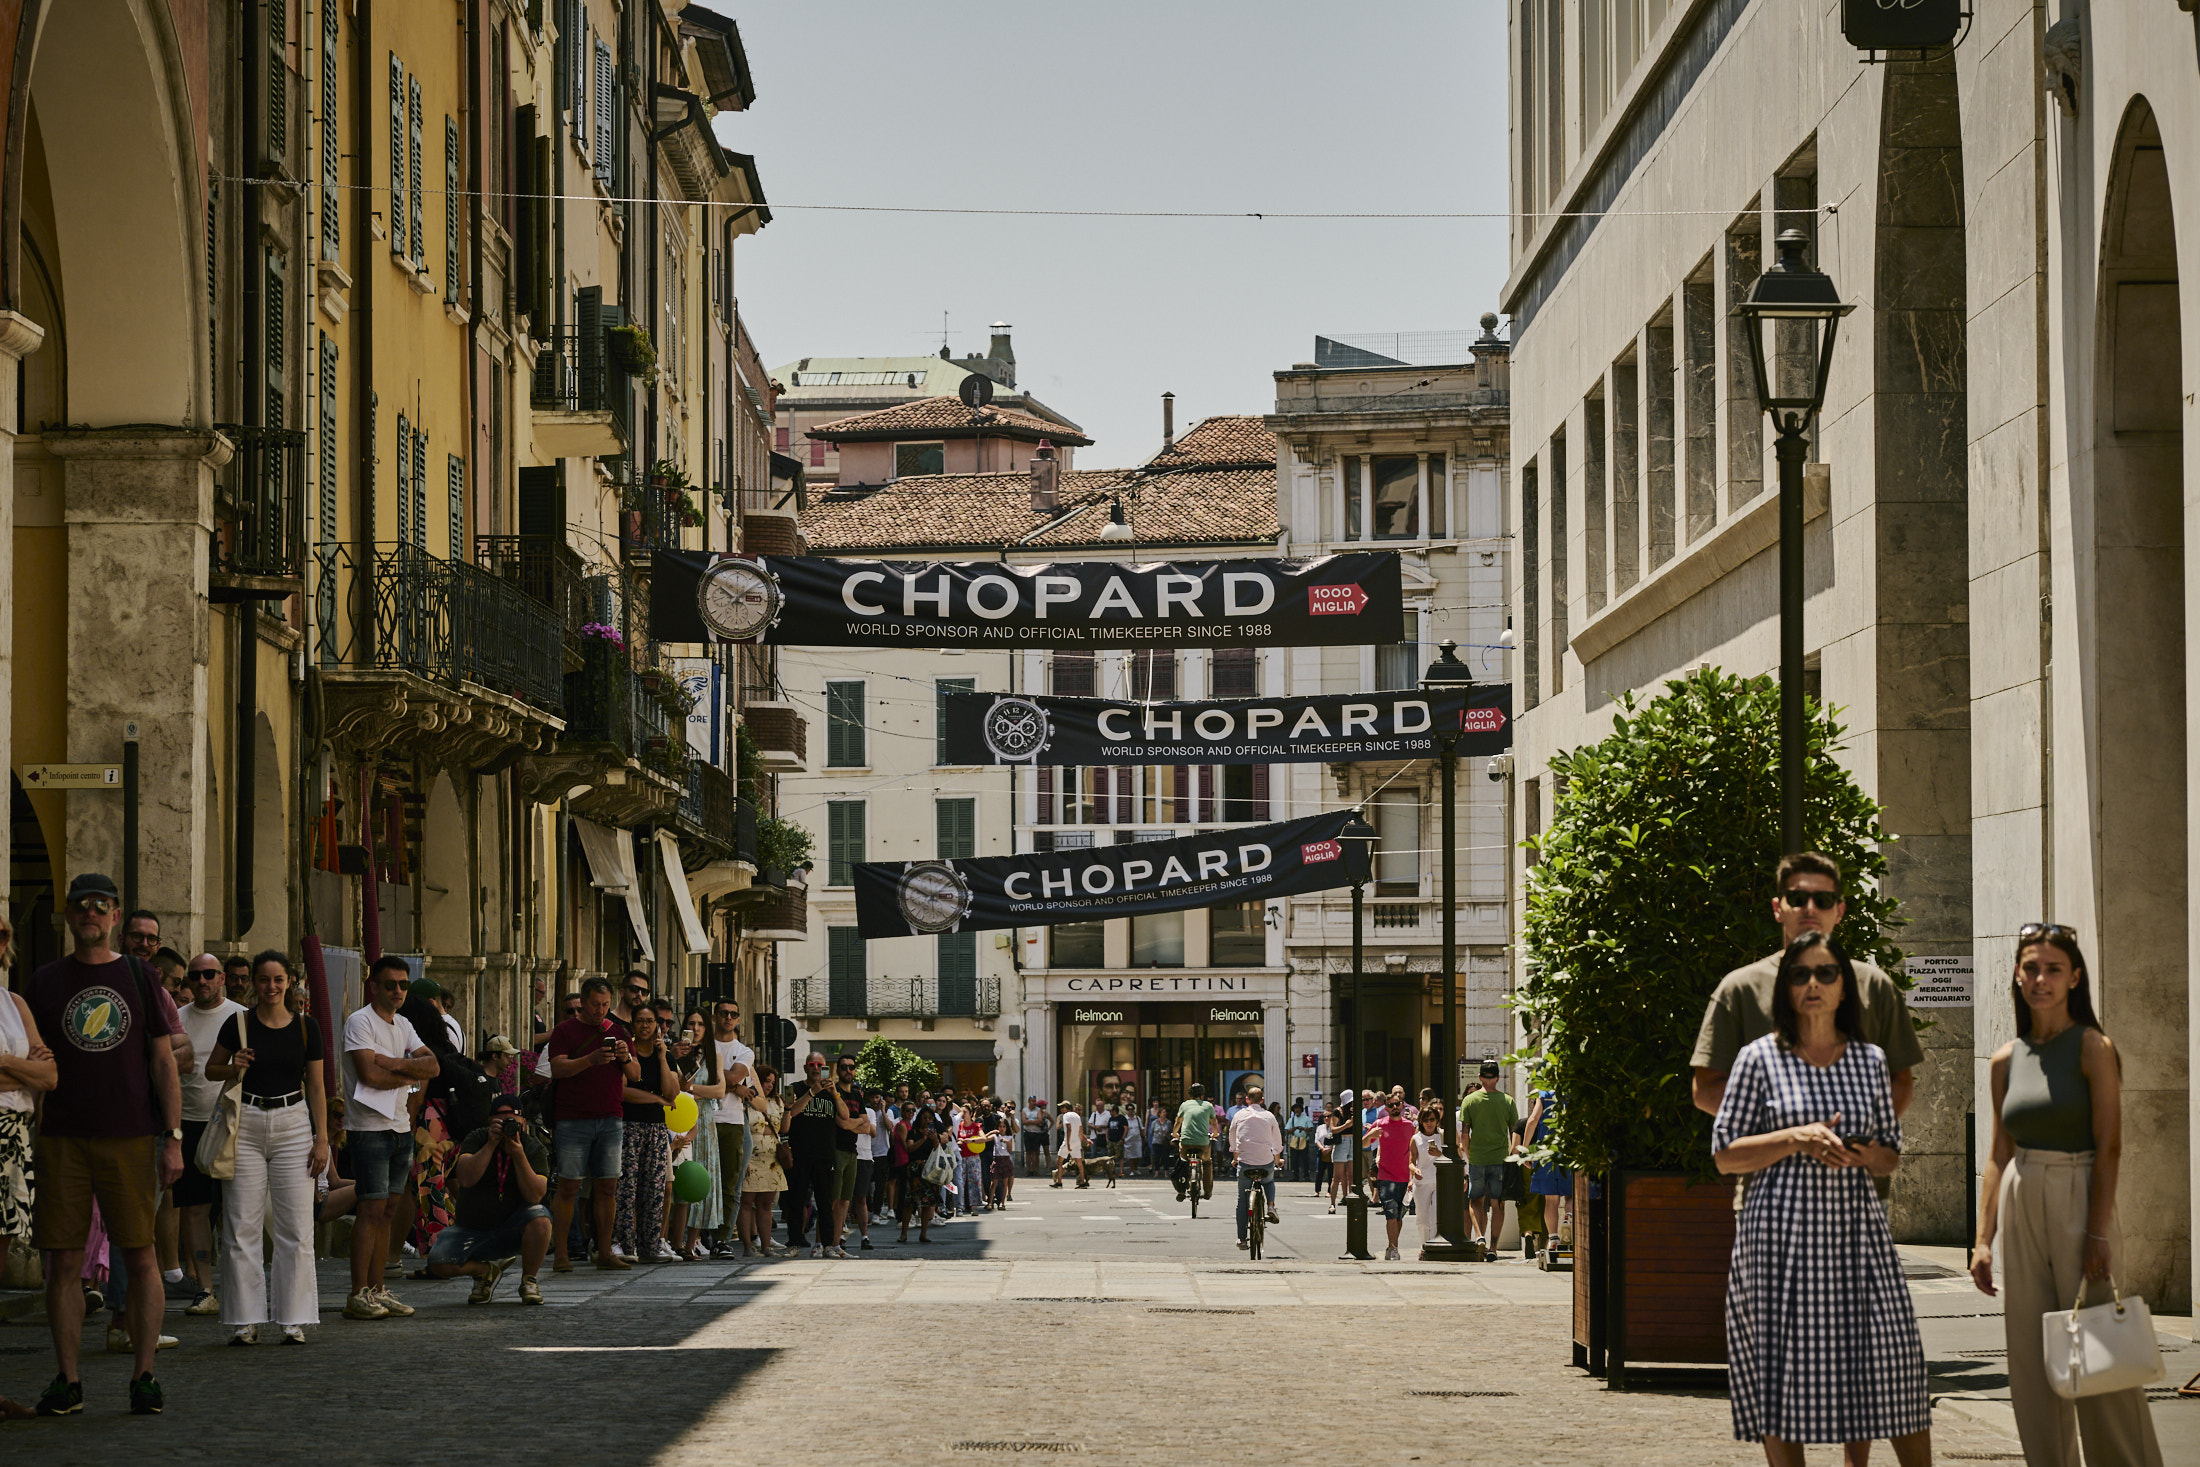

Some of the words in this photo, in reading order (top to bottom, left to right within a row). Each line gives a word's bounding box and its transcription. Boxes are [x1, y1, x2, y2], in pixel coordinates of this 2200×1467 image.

[842, 571, 1275, 619] CHOPARD
[1314, 587, 1352, 599] 1000
[1312, 600, 1356, 613] MIGLIA
[846, 623, 900, 636] WORLD
[905, 624, 978, 638] SPONSOR
[983, 627, 1014, 639] AND
[1019, 627, 1085, 640] OFFICIAL
[1090, 626, 1182, 639] TIMEKEEPER
[1187, 625, 1232, 638] SINCE
[1238, 624, 1272, 637] 1988
[1097, 700, 1432, 741] CHOPARD
[1101, 746, 1144, 756] WORLD
[1147, 746, 1204, 756] SPONSOR
[1207, 746, 1232, 756] AND
[1235, 745, 1287, 755] OFFICIAL
[1290, 742, 1362, 754] TIMEKEEPER
[1365, 740, 1400, 752] SINCE
[1404, 739, 1431, 750] 1988
[49, 772, 79, 781] Infopoint
[80, 772, 101, 780] centro
[1305, 842, 1331, 853] 1000
[1304, 850, 1335, 863] MIGLIA
[1003, 843, 1272, 900] CHOPARD
[1009, 902, 1044, 912] WORLD
[1046, 900, 1092, 910] SPONSOR
[1094, 897, 1114, 906] AND
[1116, 891, 1158, 904] OFFICIAL
[1160, 883, 1218, 898] TIMEKEEPER
[1220, 878, 1249, 890] SINCE
[1251, 873, 1273, 885] 1988
[1067, 977, 1246, 991] CAPRETTINI
[1075, 1008, 1123, 1021] fielmann
[1210, 1007, 1259, 1021] fielmann
